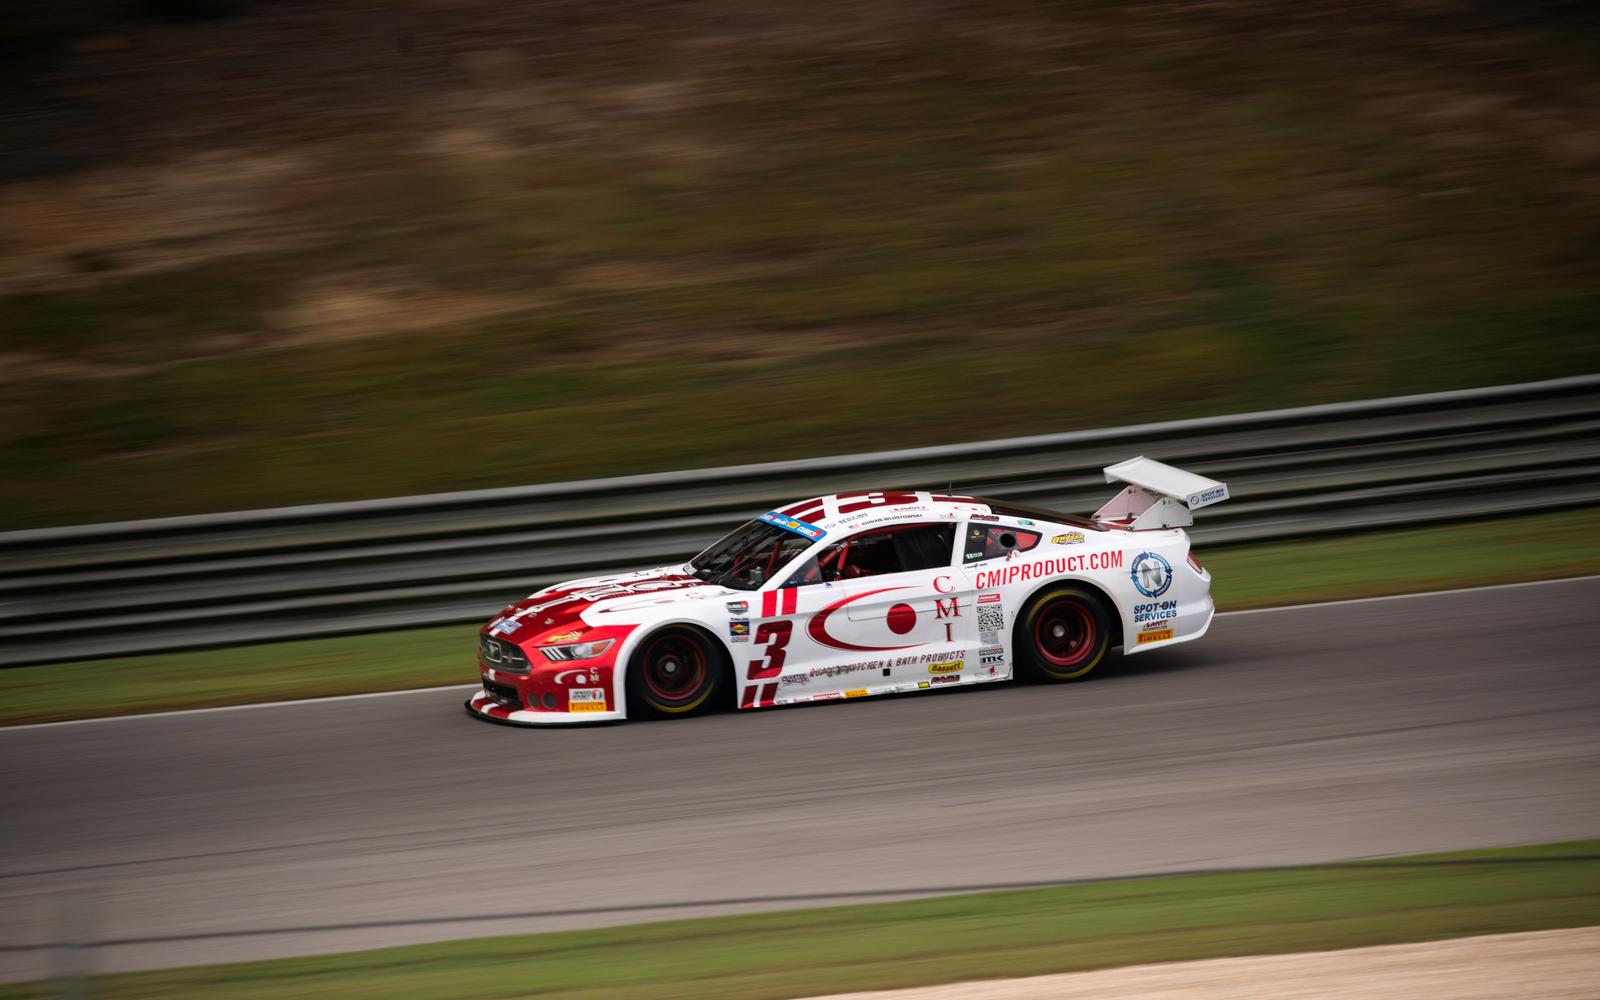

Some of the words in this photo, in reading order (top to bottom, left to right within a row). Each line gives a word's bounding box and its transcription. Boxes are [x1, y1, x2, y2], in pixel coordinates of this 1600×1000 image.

[1201, 488, 1224, 499] SPOT-ON
[975, 550, 1123, 590] CMIPRODUCT.COM
[1133, 600, 1177, 615] SPOT-ON
[1134, 610, 1177, 623] SERVICES
[746, 620, 793, 680] 3
[896, 655, 917, 667] BATH
